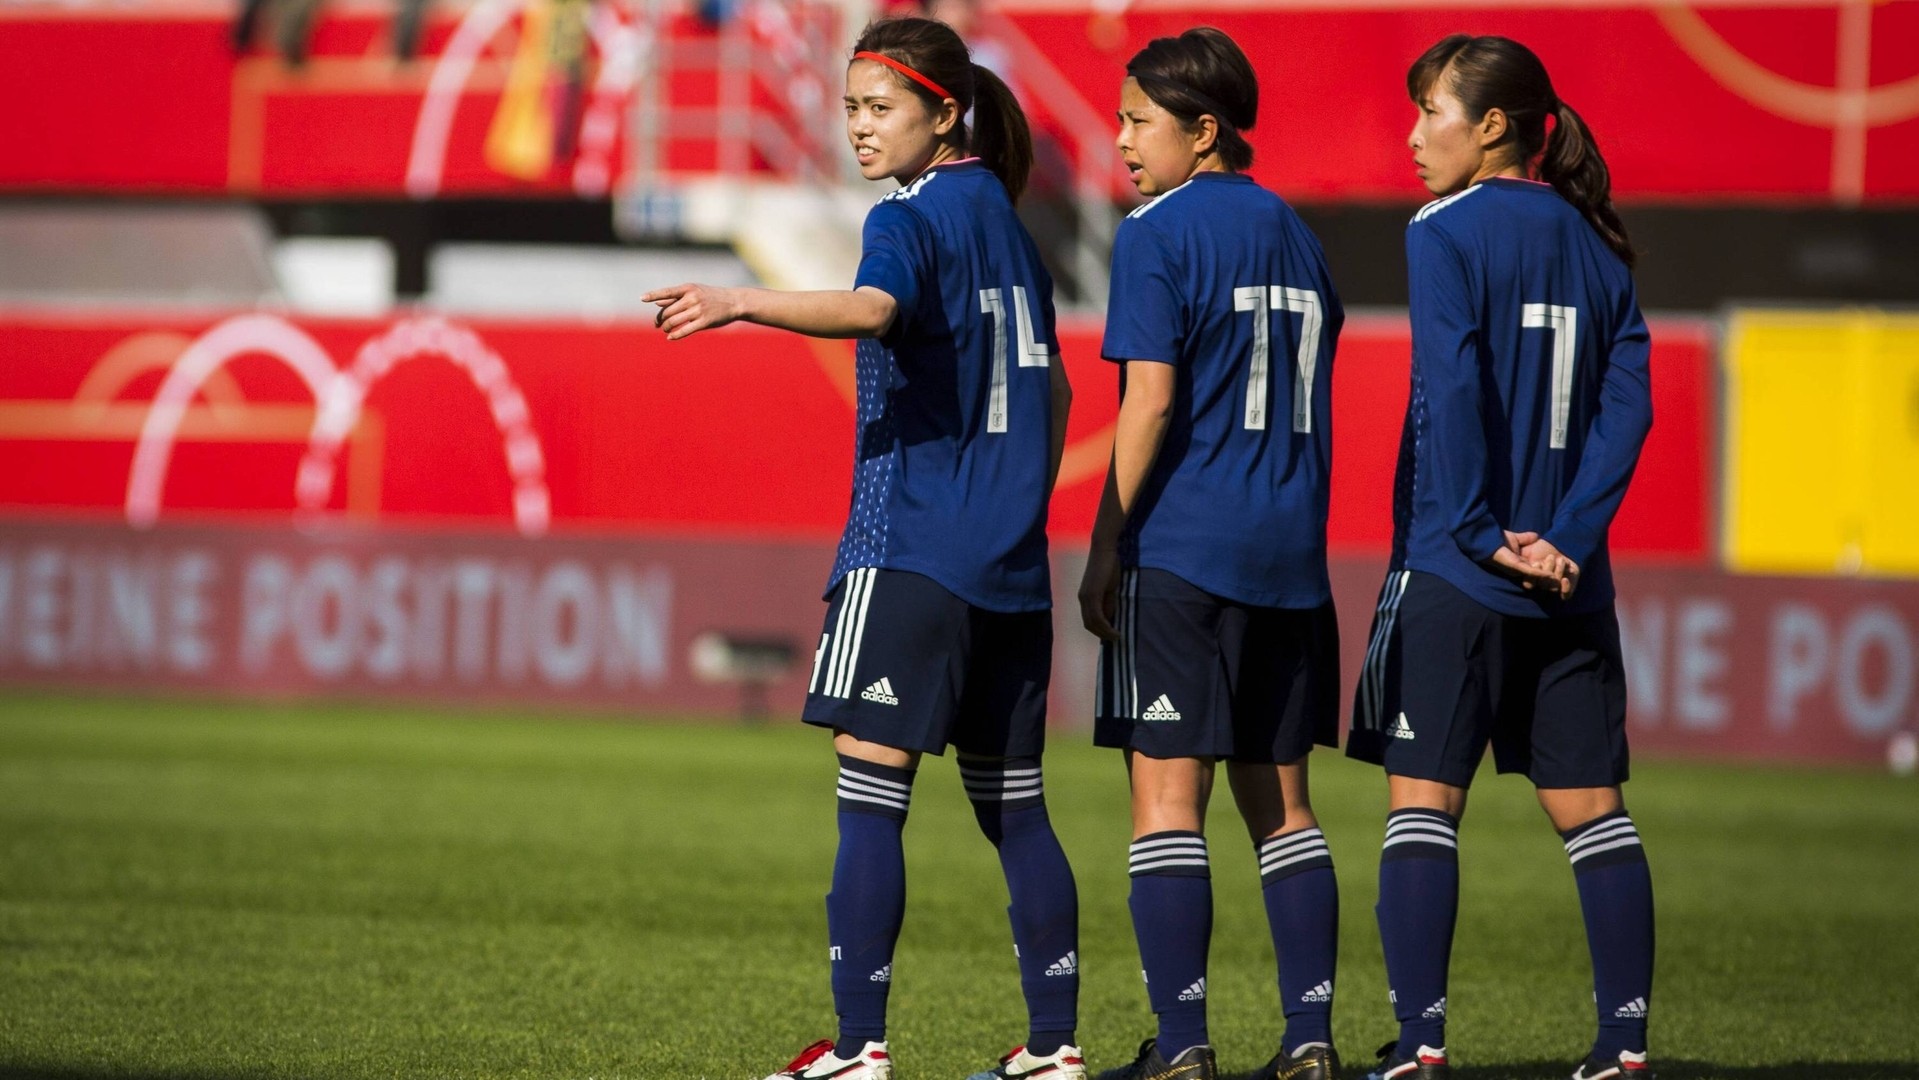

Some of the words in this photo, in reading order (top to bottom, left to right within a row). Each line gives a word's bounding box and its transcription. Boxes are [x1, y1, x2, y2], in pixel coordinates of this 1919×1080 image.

[239, 555, 674, 690] POSITION
[861, 691, 899, 706] adidas
[1142, 711, 1182, 721] adidas
